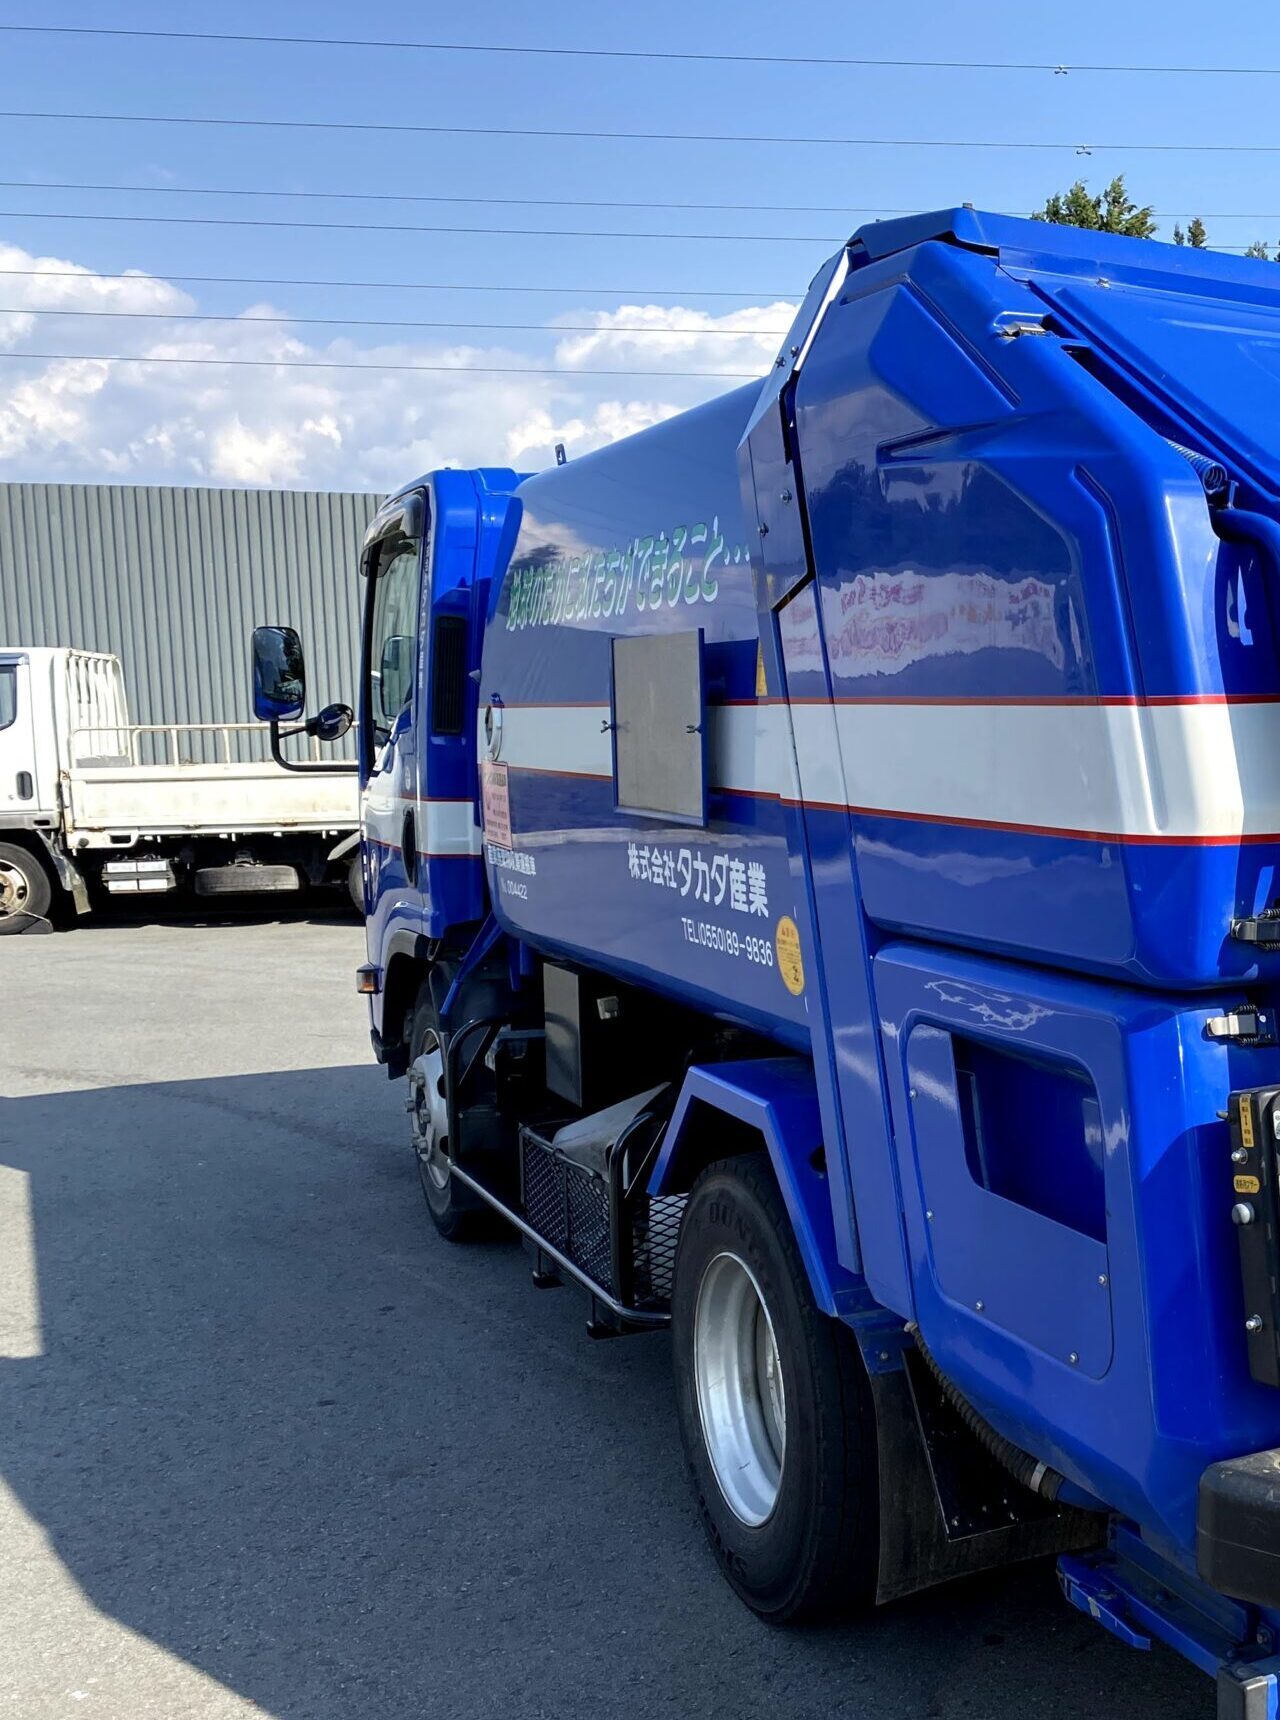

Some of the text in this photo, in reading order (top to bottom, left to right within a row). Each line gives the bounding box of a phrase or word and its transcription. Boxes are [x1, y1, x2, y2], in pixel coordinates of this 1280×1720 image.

[627, 841, 770, 919] 株式会社タカダ産業
